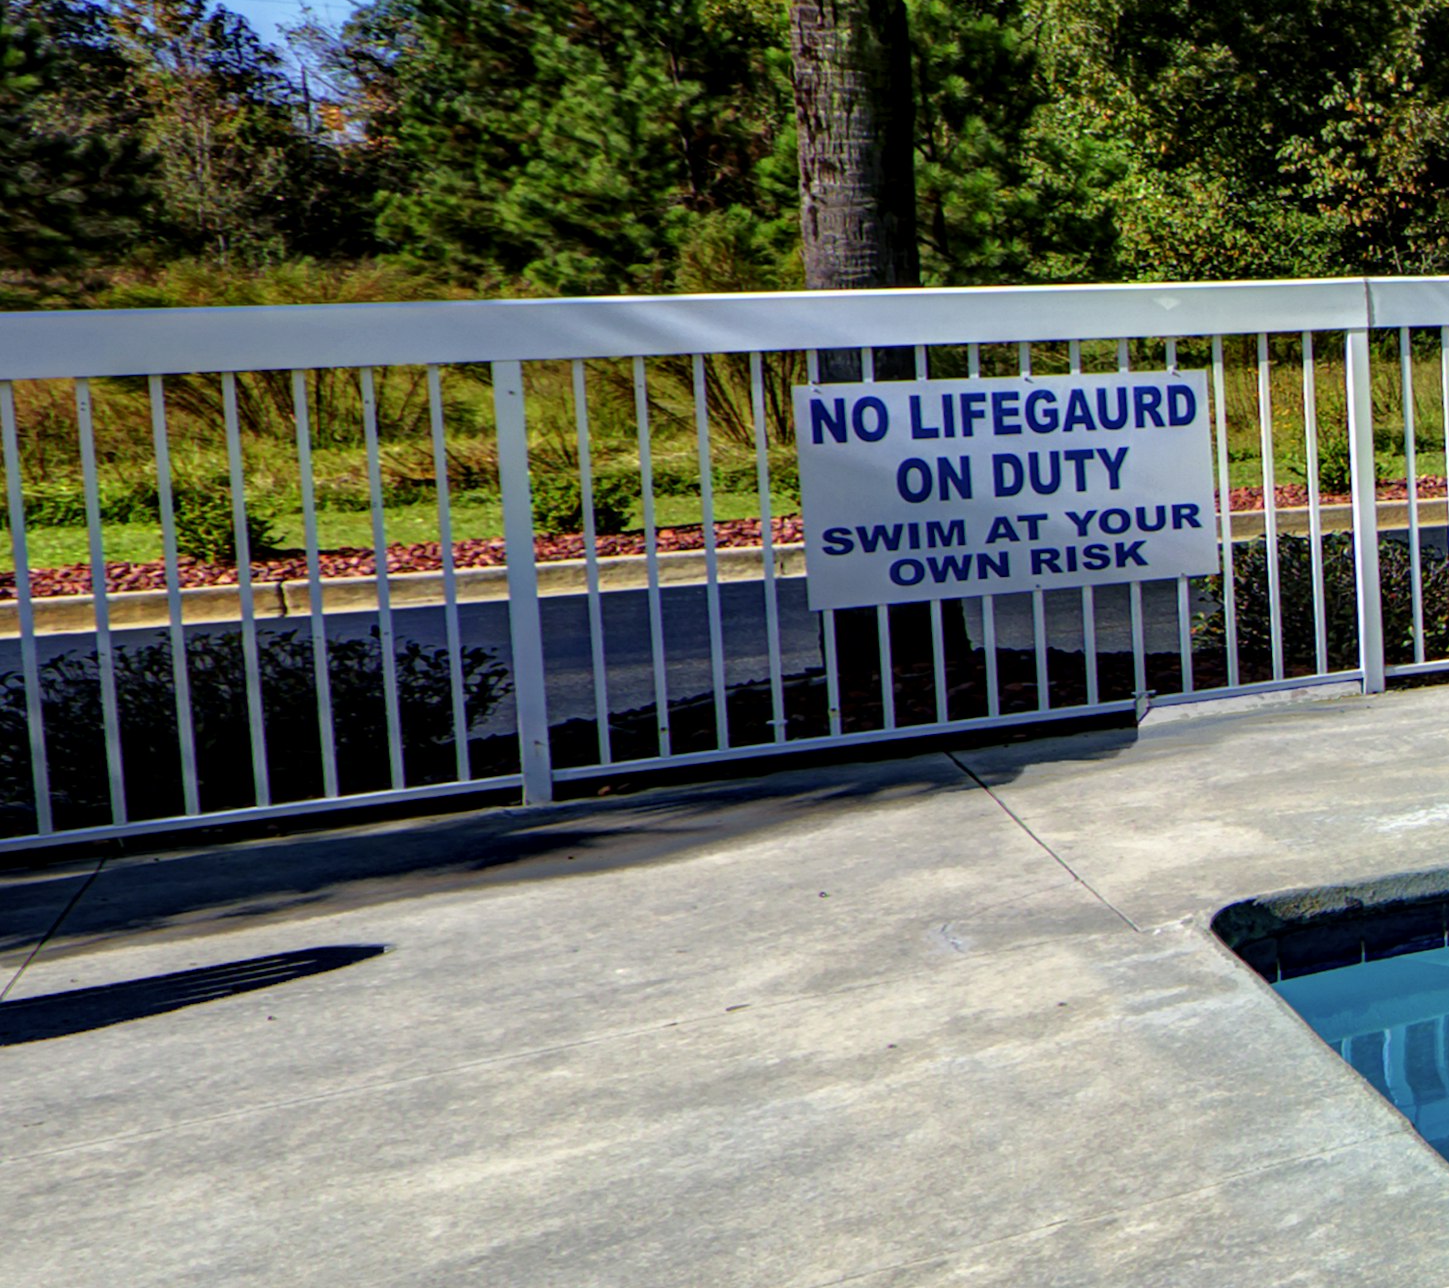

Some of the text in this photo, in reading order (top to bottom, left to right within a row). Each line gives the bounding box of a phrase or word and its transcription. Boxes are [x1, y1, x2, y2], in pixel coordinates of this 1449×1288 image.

[810, 384, 1197, 445] NO LIFEGAURD
[898, 446, 1129, 504] ON DUTY
[821, 502, 1202, 556] SWIM AT YOUR
[889, 539, 1149, 586] OWN RISK
